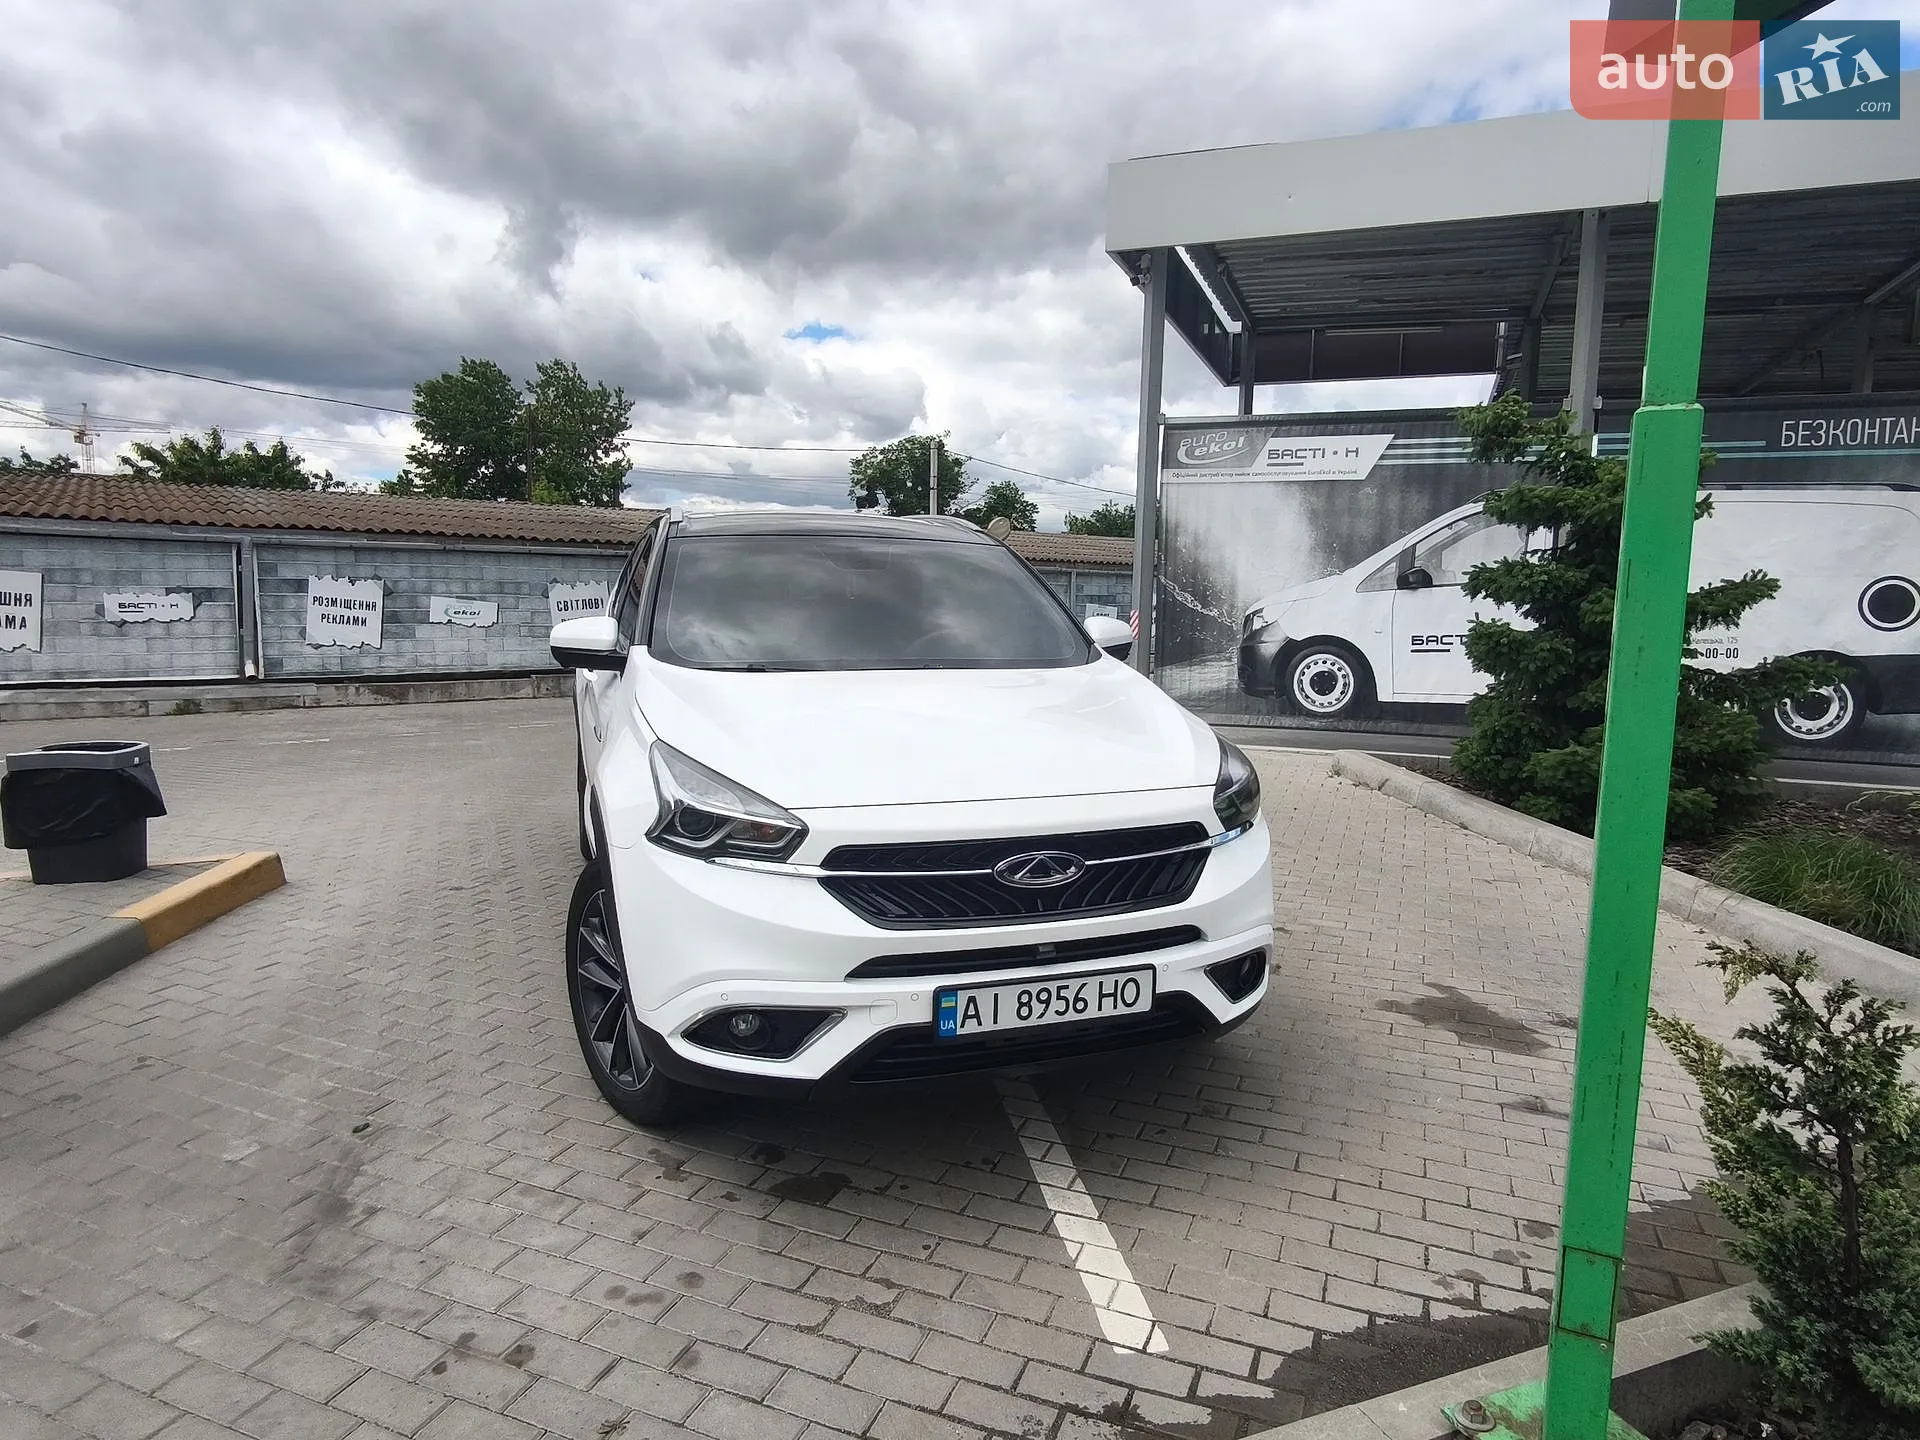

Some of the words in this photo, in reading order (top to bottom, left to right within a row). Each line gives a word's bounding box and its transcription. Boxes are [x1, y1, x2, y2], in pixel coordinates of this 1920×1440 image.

[1180, 431, 1228, 448] euro
[312, 595, 377, 612] РОЗМІЩЕННЯ
[556, 598, 604, 612] СВІТЛОВІ
[0, 614, 27, 630] МА
[320, 613, 368, 627] РЕКЛАМИ
[959, 992, 999, 1029] AI
[1016, 982, 1089, 1022] 8956
[1097, 976, 1141, 1013] HO
[940, 1019, 955, 1031] UA
